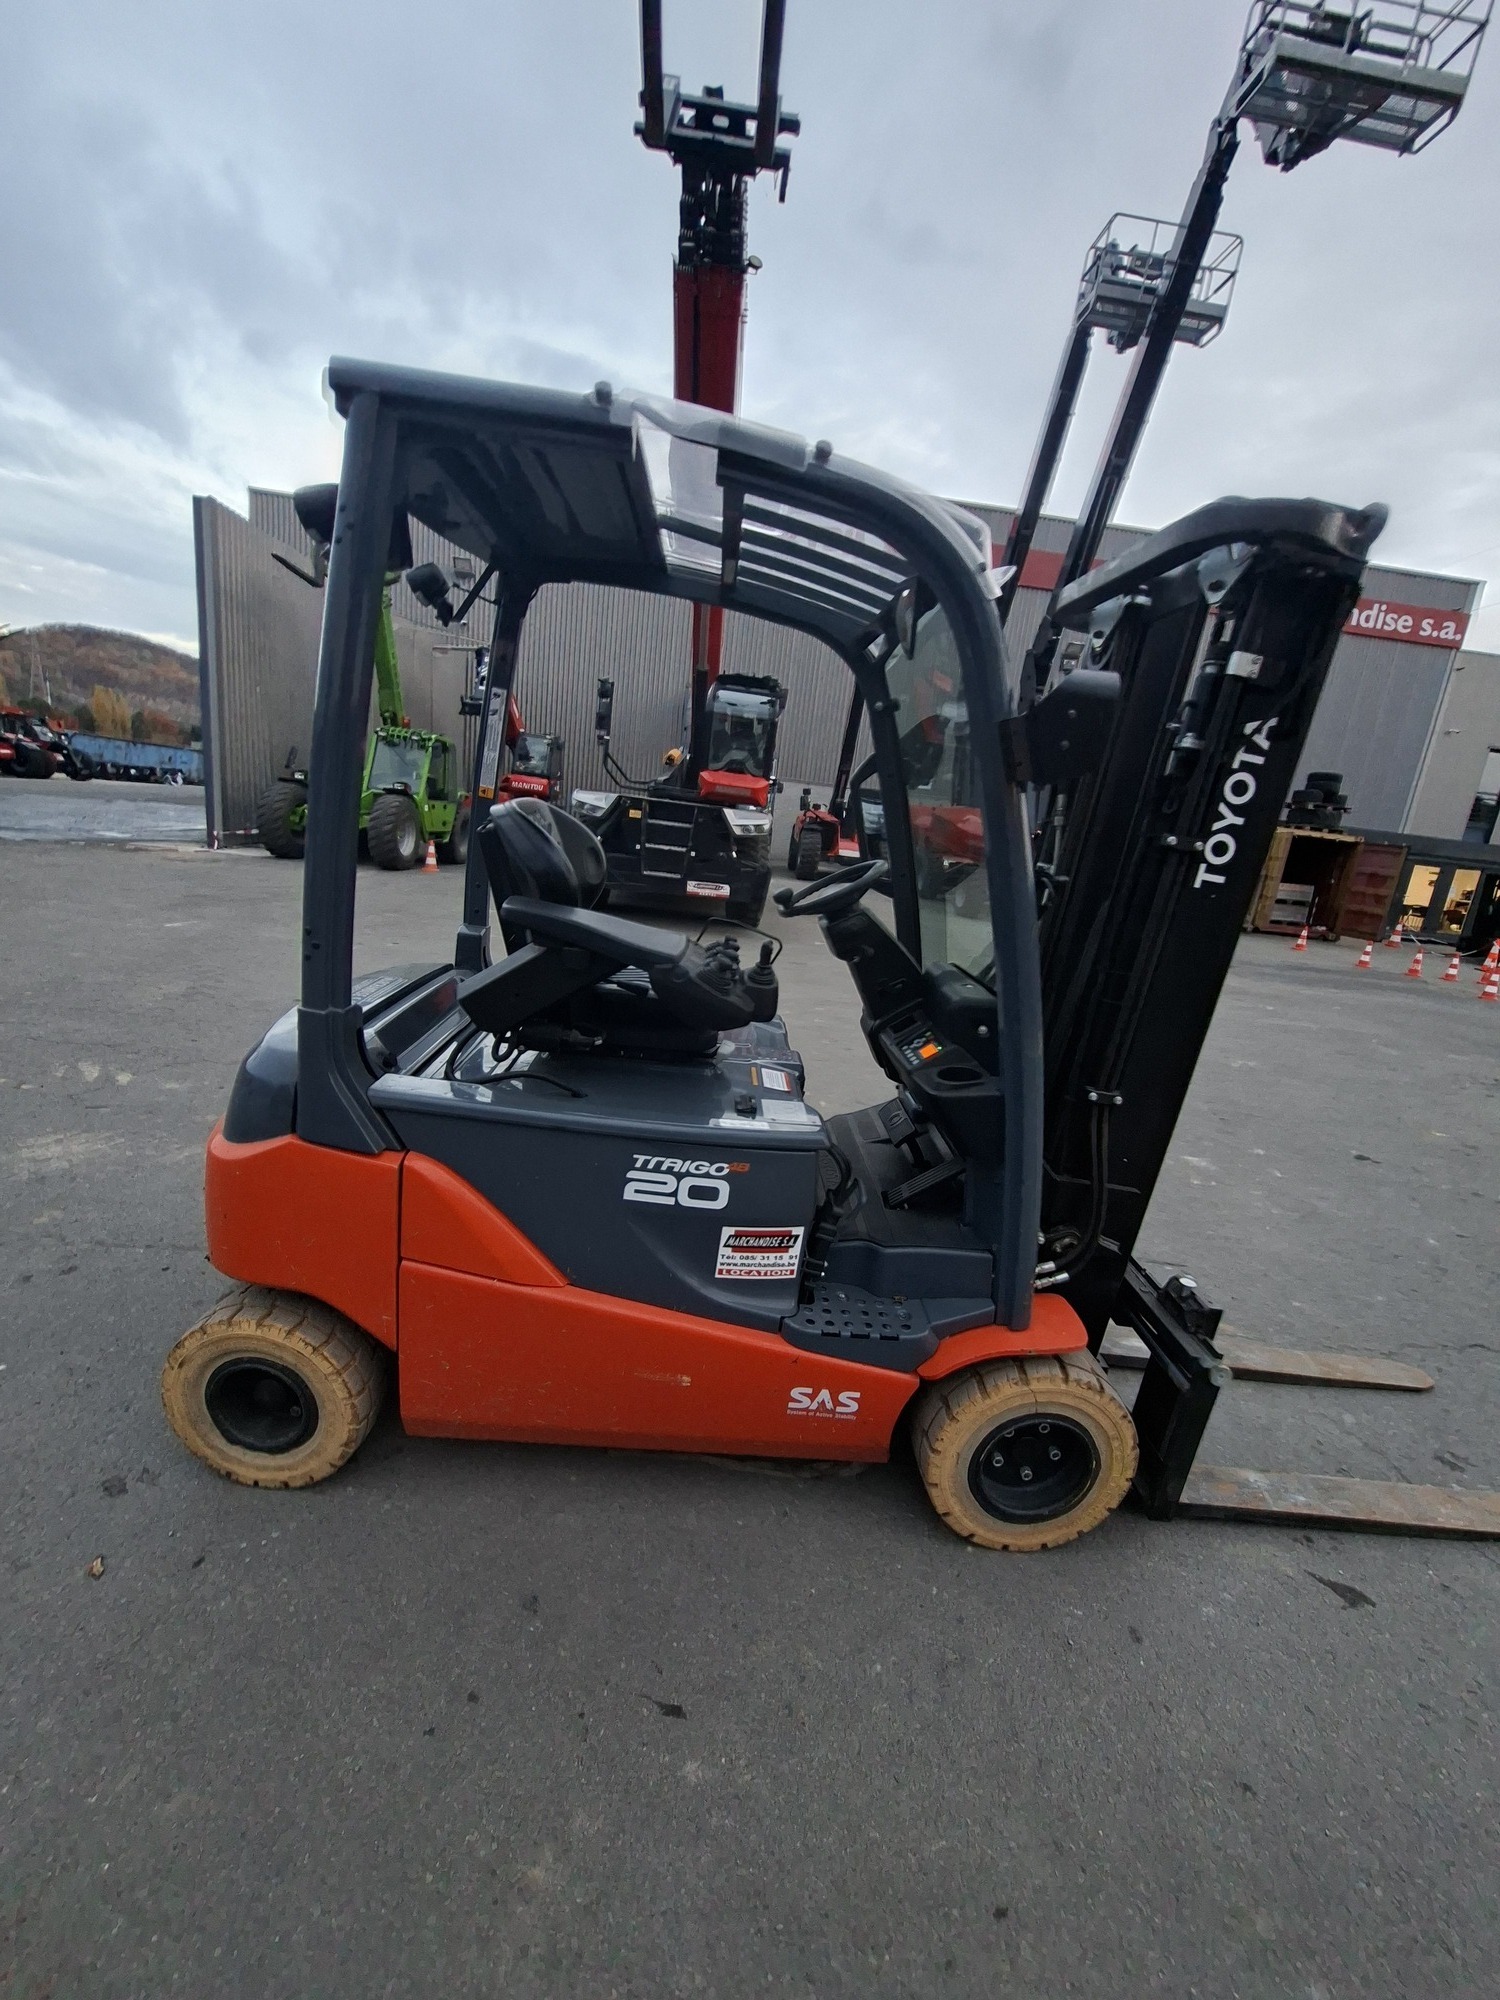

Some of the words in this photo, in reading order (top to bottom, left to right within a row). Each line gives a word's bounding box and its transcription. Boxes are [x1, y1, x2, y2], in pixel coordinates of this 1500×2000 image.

[1419, 618, 1462, 640] s.a.
[511, 781, 544, 791] MANITOU
[1193, 717, 1279, 889] TOYOTA
[633, 1154, 730, 1176] TRAIGO
[623, 1170, 730, 1210] 20
[725, 1236, 782, 1247] MARCHANDISE
[722, 1269, 791, 1277] LOCATION
[787, 1387, 861, 1414] SAS
